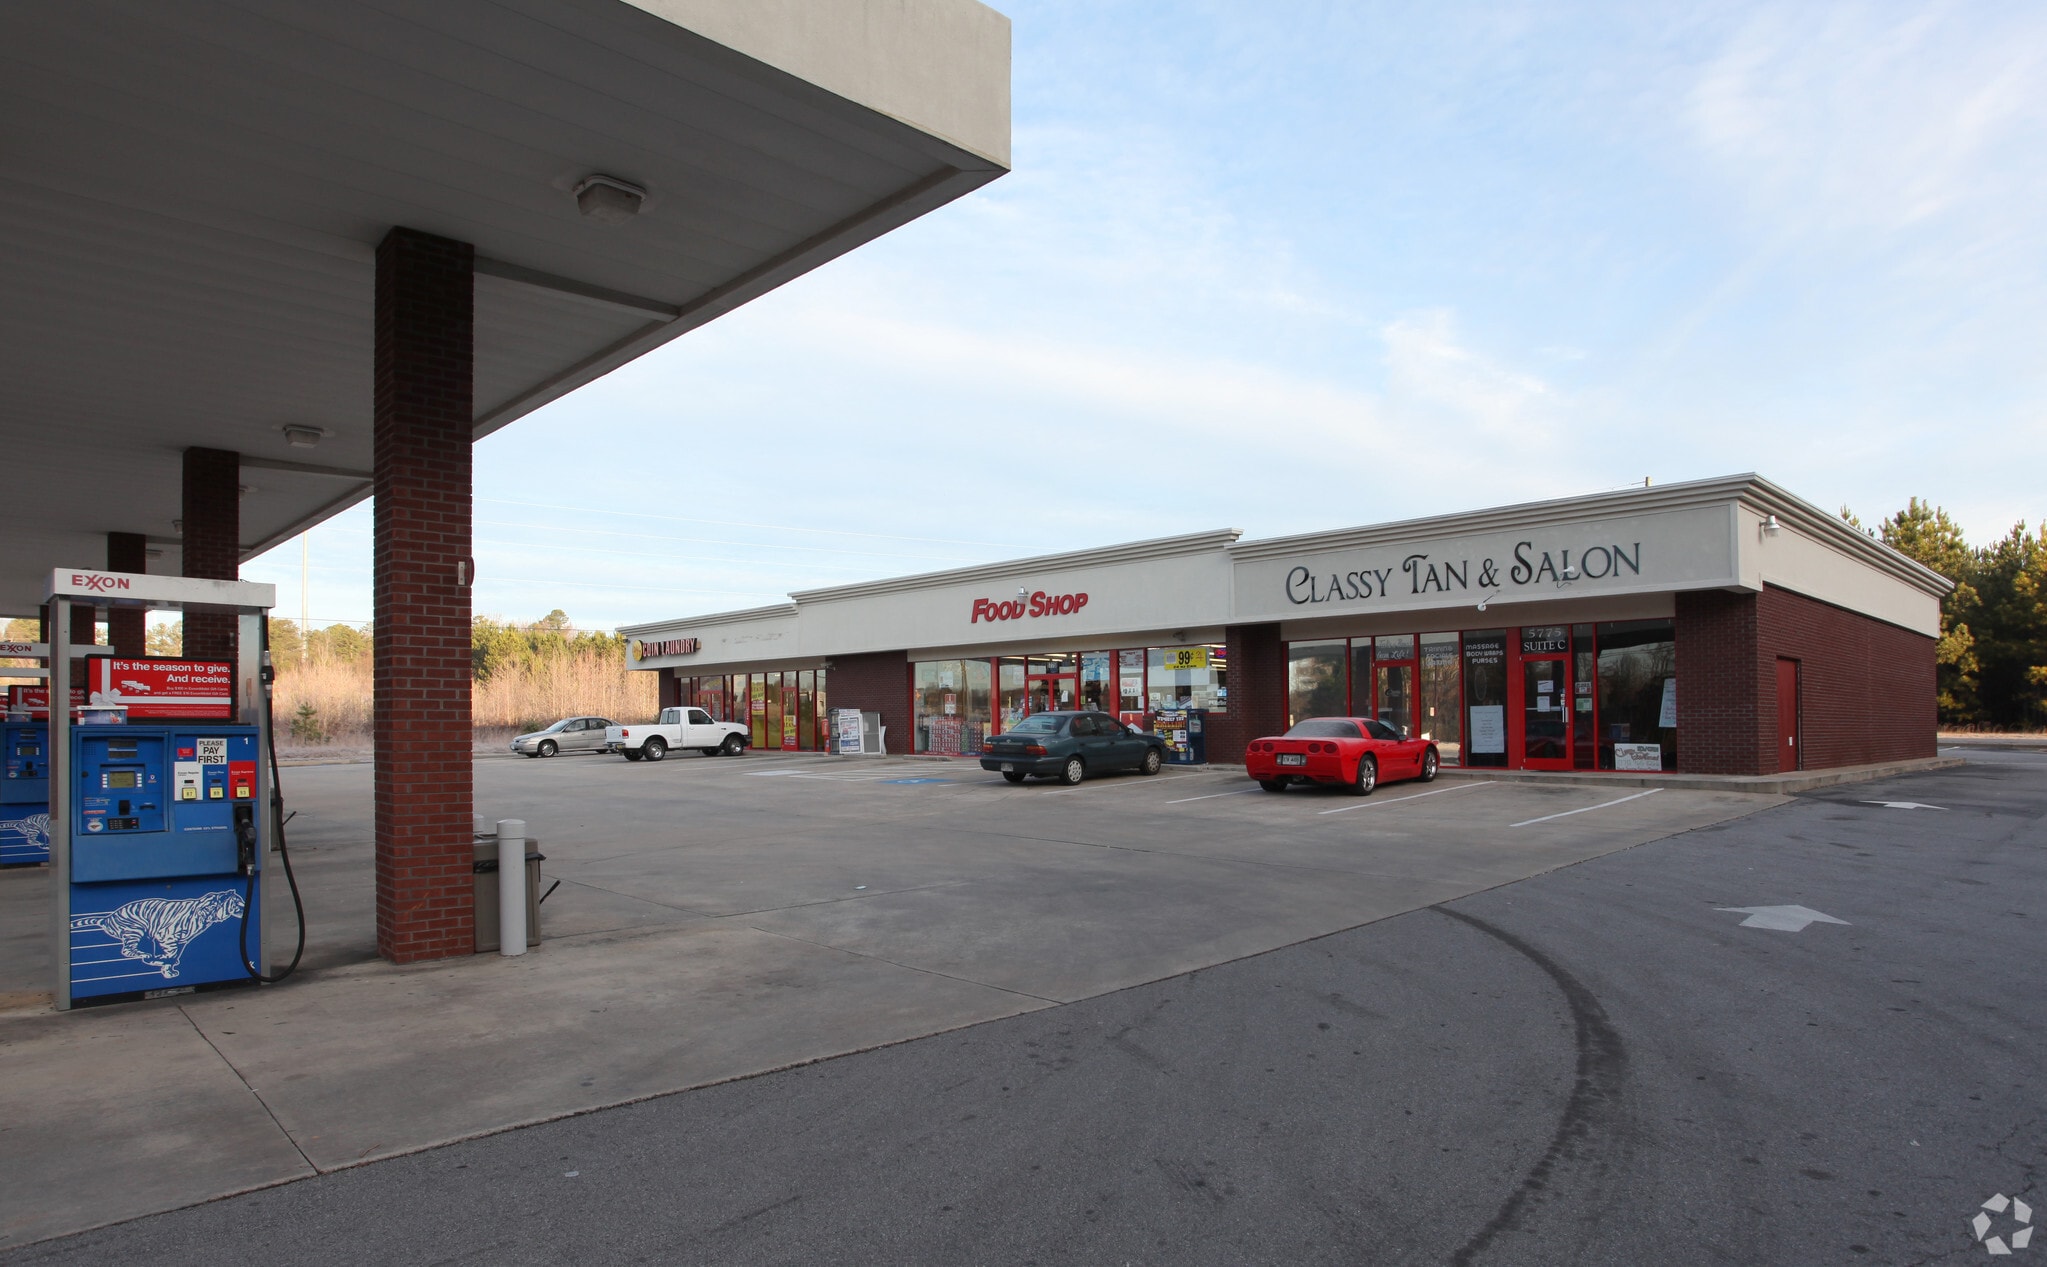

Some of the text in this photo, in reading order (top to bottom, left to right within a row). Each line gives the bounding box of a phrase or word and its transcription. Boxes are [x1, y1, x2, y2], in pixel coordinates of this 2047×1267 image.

[1286, 541, 1641, 605] CLASSY TAN & SALON
[71, 574, 130, 592] EXXON
[971, 590, 1089, 624] FOOD SHOP
[1529, 628, 1562, 638] 5775
[0, 644, 32, 653] EXXON
[642, 638, 697, 657] COIN LAUNDRY
[1523, 640, 1566, 651] SUITE C
[113, 661, 231, 674] It's the season to give.
[166, 674, 231, 684] And receive.
[243, 737, 249, 745] 1
[203, 746, 220, 755] PAY
[198, 755, 225, 764] FIRST
